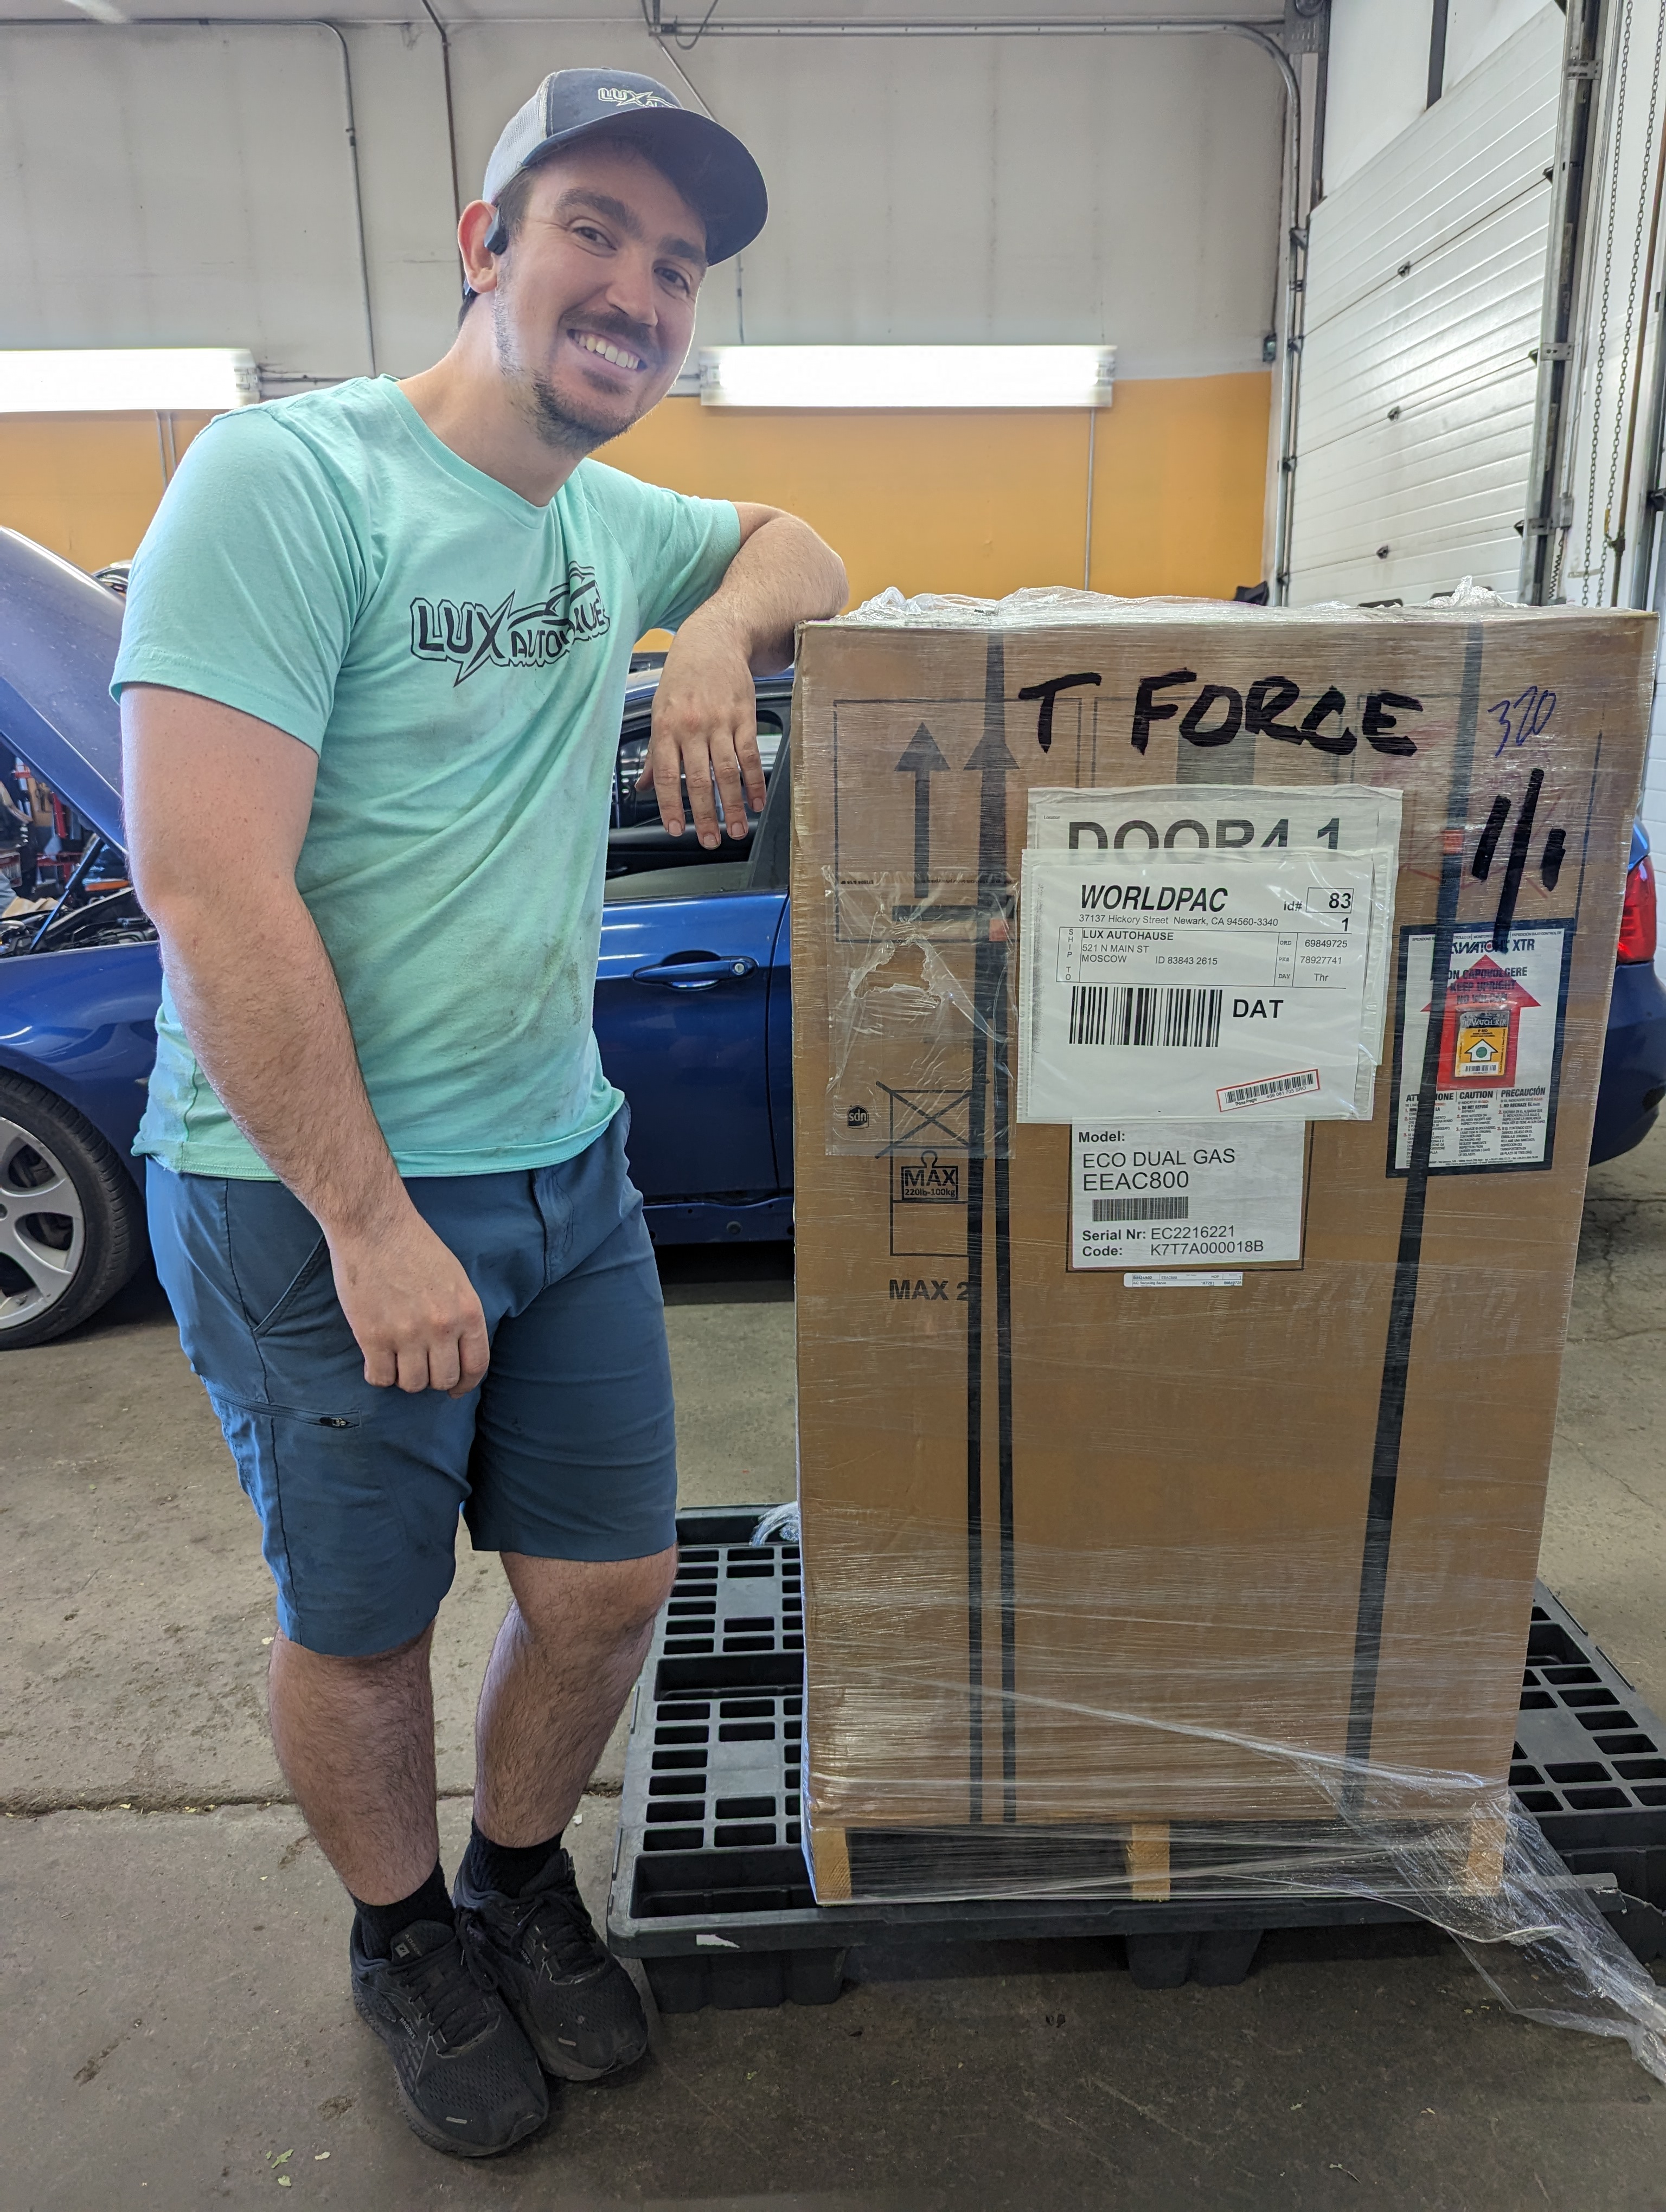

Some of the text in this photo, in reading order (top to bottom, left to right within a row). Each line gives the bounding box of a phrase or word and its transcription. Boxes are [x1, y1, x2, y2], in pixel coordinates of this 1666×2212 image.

[598, 88, 653, 107] LUX
[415, 594, 512, 678] LUX
[1018, 667, 1423, 756] T FORCE
[1081, 885, 1228, 912] WORLDPAC
[1283, 901, 1303, 911] id#
[1329, 892, 1351, 909] 83
[1079, 915, 1105, 923] 37137
[1108, 915, 1140, 925] Hickory
[1142, 916, 1169, 924] Street
[1174, 917, 1208, 926] Newark,
[1227, 917, 1278, 926] 94560-3340
[1341, 917, 1349, 932] 1
[1083, 930, 1174, 940] LUX AUTOHAUSE
[1082, 944, 1098, 952] 521
[1110, 944, 1135, 953] MAIN
[1137, 945, 1150, 953] ST
[1305, 940, 1348, 948] 69849725
[1513, 938, 1535, 951] XTR
[1081, 955, 1218, 965] MOSCOW ID 83843 2615
[1300, 956, 1342, 964] 78927741
[1314, 973, 1329, 981] Thr
[1233, 999, 1284, 1018] DAT
[1459, 1090, 1494, 1099] CAUTION
[1501, 1085, 1546, 1097] PRECAUCIÓN
[1079, 1130, 1125, 1143] Model:
[1083, 1148, 1235, 1168] ECO DUAL GAS
[905, 1169, 956, 1186] MAX
[1083, 1171, 1189, 1191] EEAC800
[905, 1188, 956, 1197] 220lb-100kg
[1082, 1225, 1235, 1242] Serial Nr: EC2216221
[1082, 1240, 1264, 1257] Code: K7T7A000018B
[889, 1279, 949, 1300] MAX
[400, 2017, 416, 2040] BROOKS
